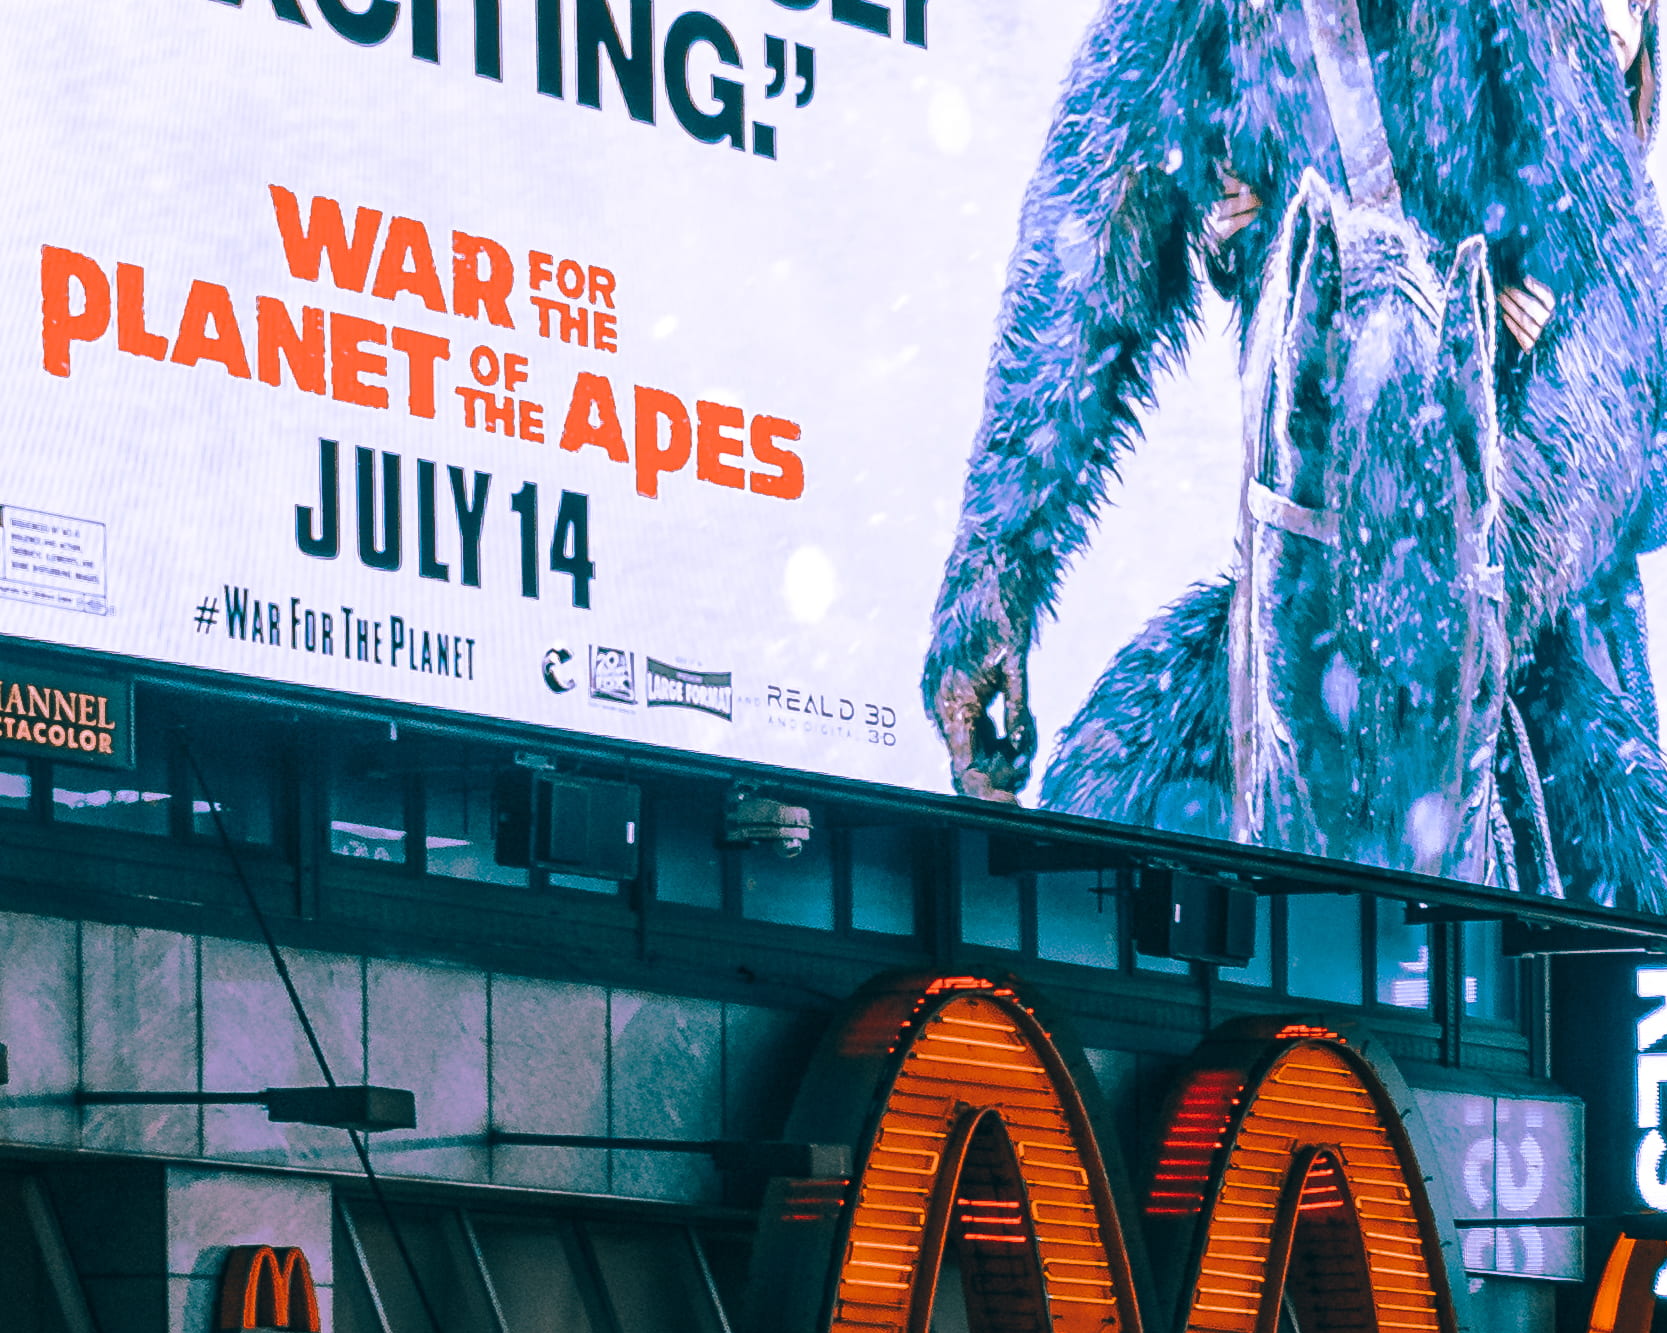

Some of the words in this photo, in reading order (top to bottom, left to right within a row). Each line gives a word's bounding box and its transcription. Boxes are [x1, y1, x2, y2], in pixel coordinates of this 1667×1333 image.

[268, 184, 516, 329] WAR
[529, 251, 617, 306] FOR
[41, 245, 450, 419] PLANET
[472, 346, 528, 392] OF
[530, 296, 617, 354] THE
[455, 387, 544, 446] THE
[560, 371, 804, 500] APES
[295, 437, 492, 588] JULY
[511, 481, 596, 609] 14
[0, 716, 113, 754] TACOLOR
[865, 703, 896, 729] 3D
[868, 729, 897, 747] 3D
